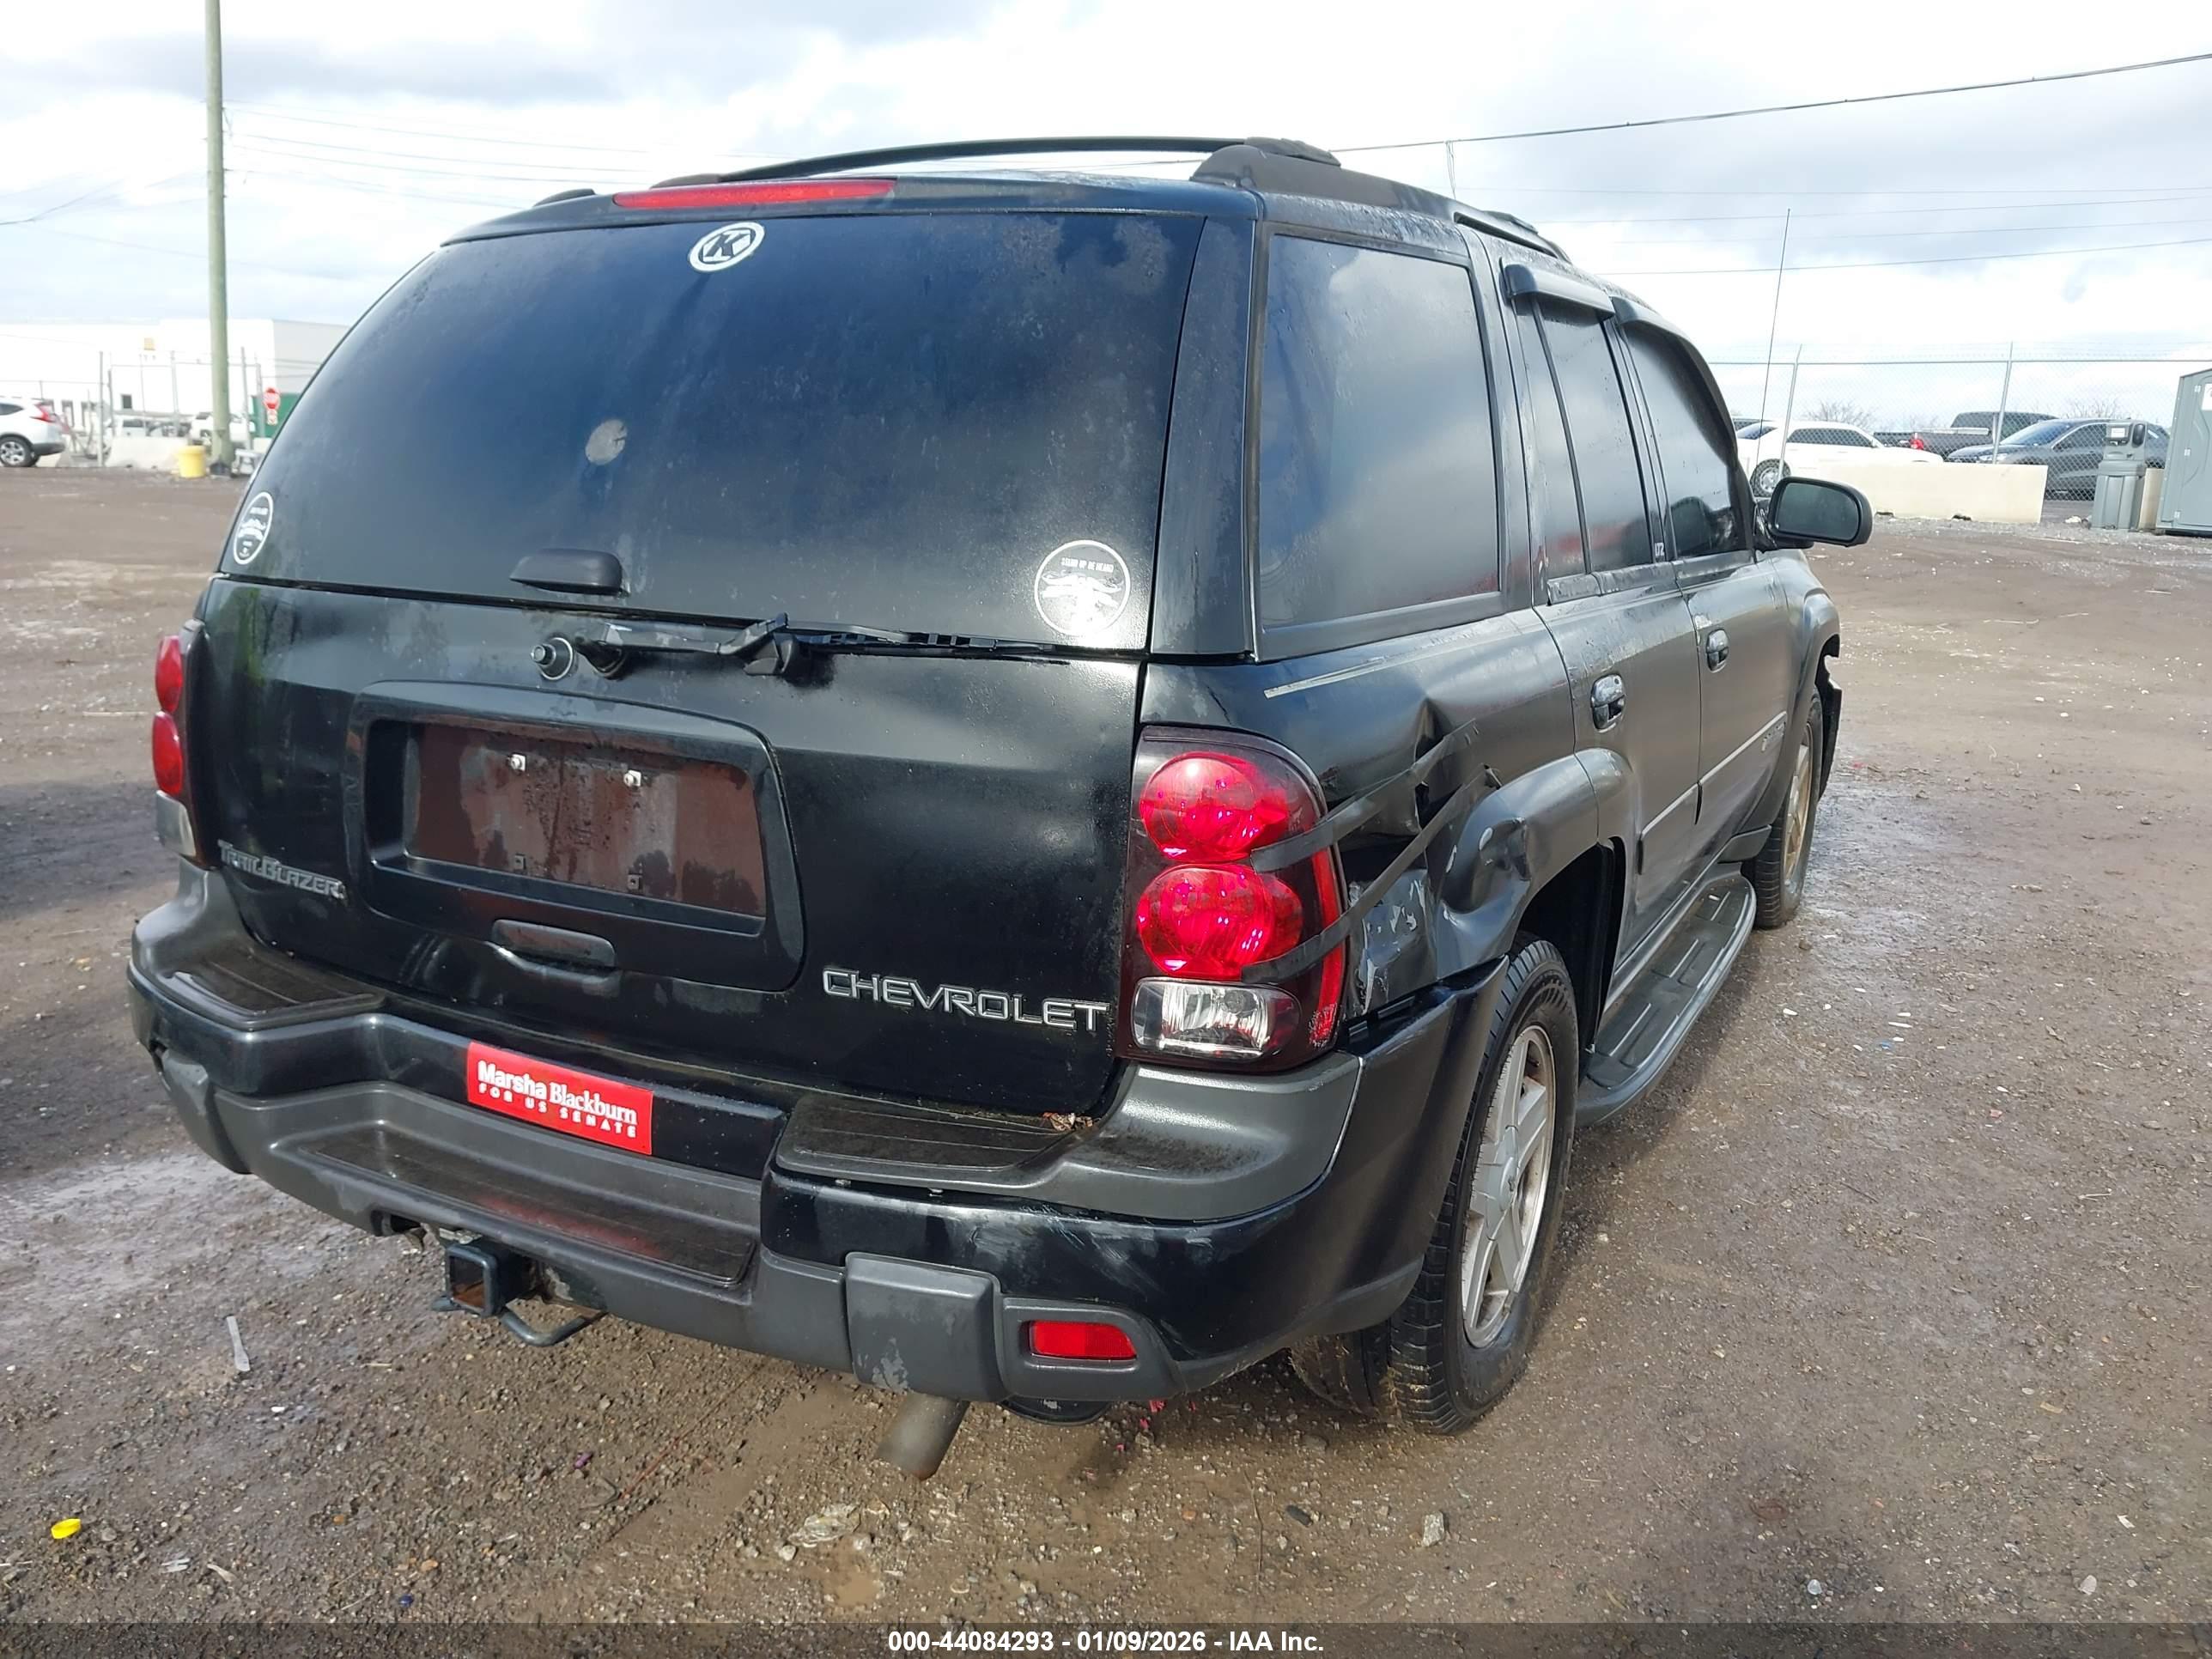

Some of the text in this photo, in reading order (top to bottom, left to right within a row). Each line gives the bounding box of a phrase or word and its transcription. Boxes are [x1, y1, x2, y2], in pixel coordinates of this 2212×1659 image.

[217, 839, 345, 899] TRAILBLAZER
[823, 966, 1110, 1032] CHEVROLET
[477, 1060, 638, 1126] Marsha Blackburn
[478, 1082, 636, 1138] FOR US SENATE
